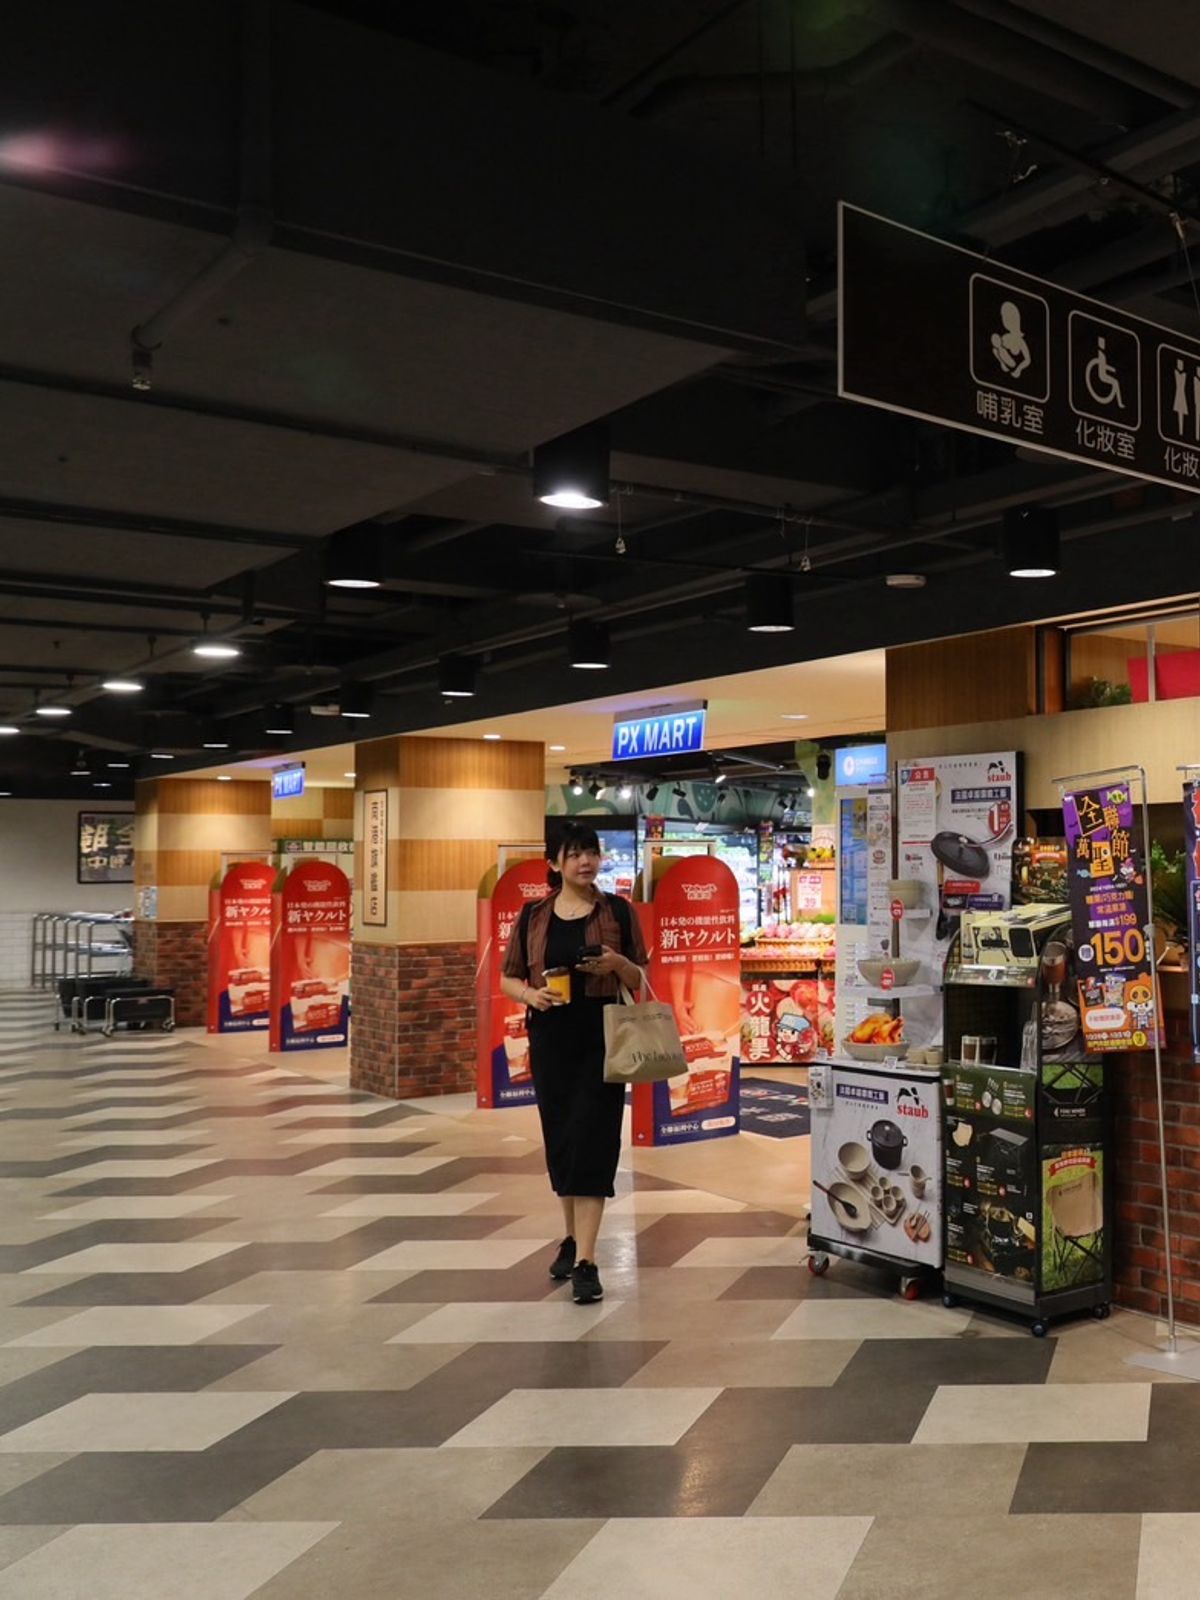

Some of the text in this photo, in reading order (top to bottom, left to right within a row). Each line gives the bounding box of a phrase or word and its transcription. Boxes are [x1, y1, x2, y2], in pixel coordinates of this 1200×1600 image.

[976, 390, 1045, 435] 哺乳室
[1076, 418, 1136, 460] 化妝室
[617, 716, 697, 755] PX MART
[988, 772, 1011, 783] staub
[660, 927, 736, 949] 新ヤクルト
[1090, 928, 1145, 966] 150
[897, 1104, 929, 1118] staub
